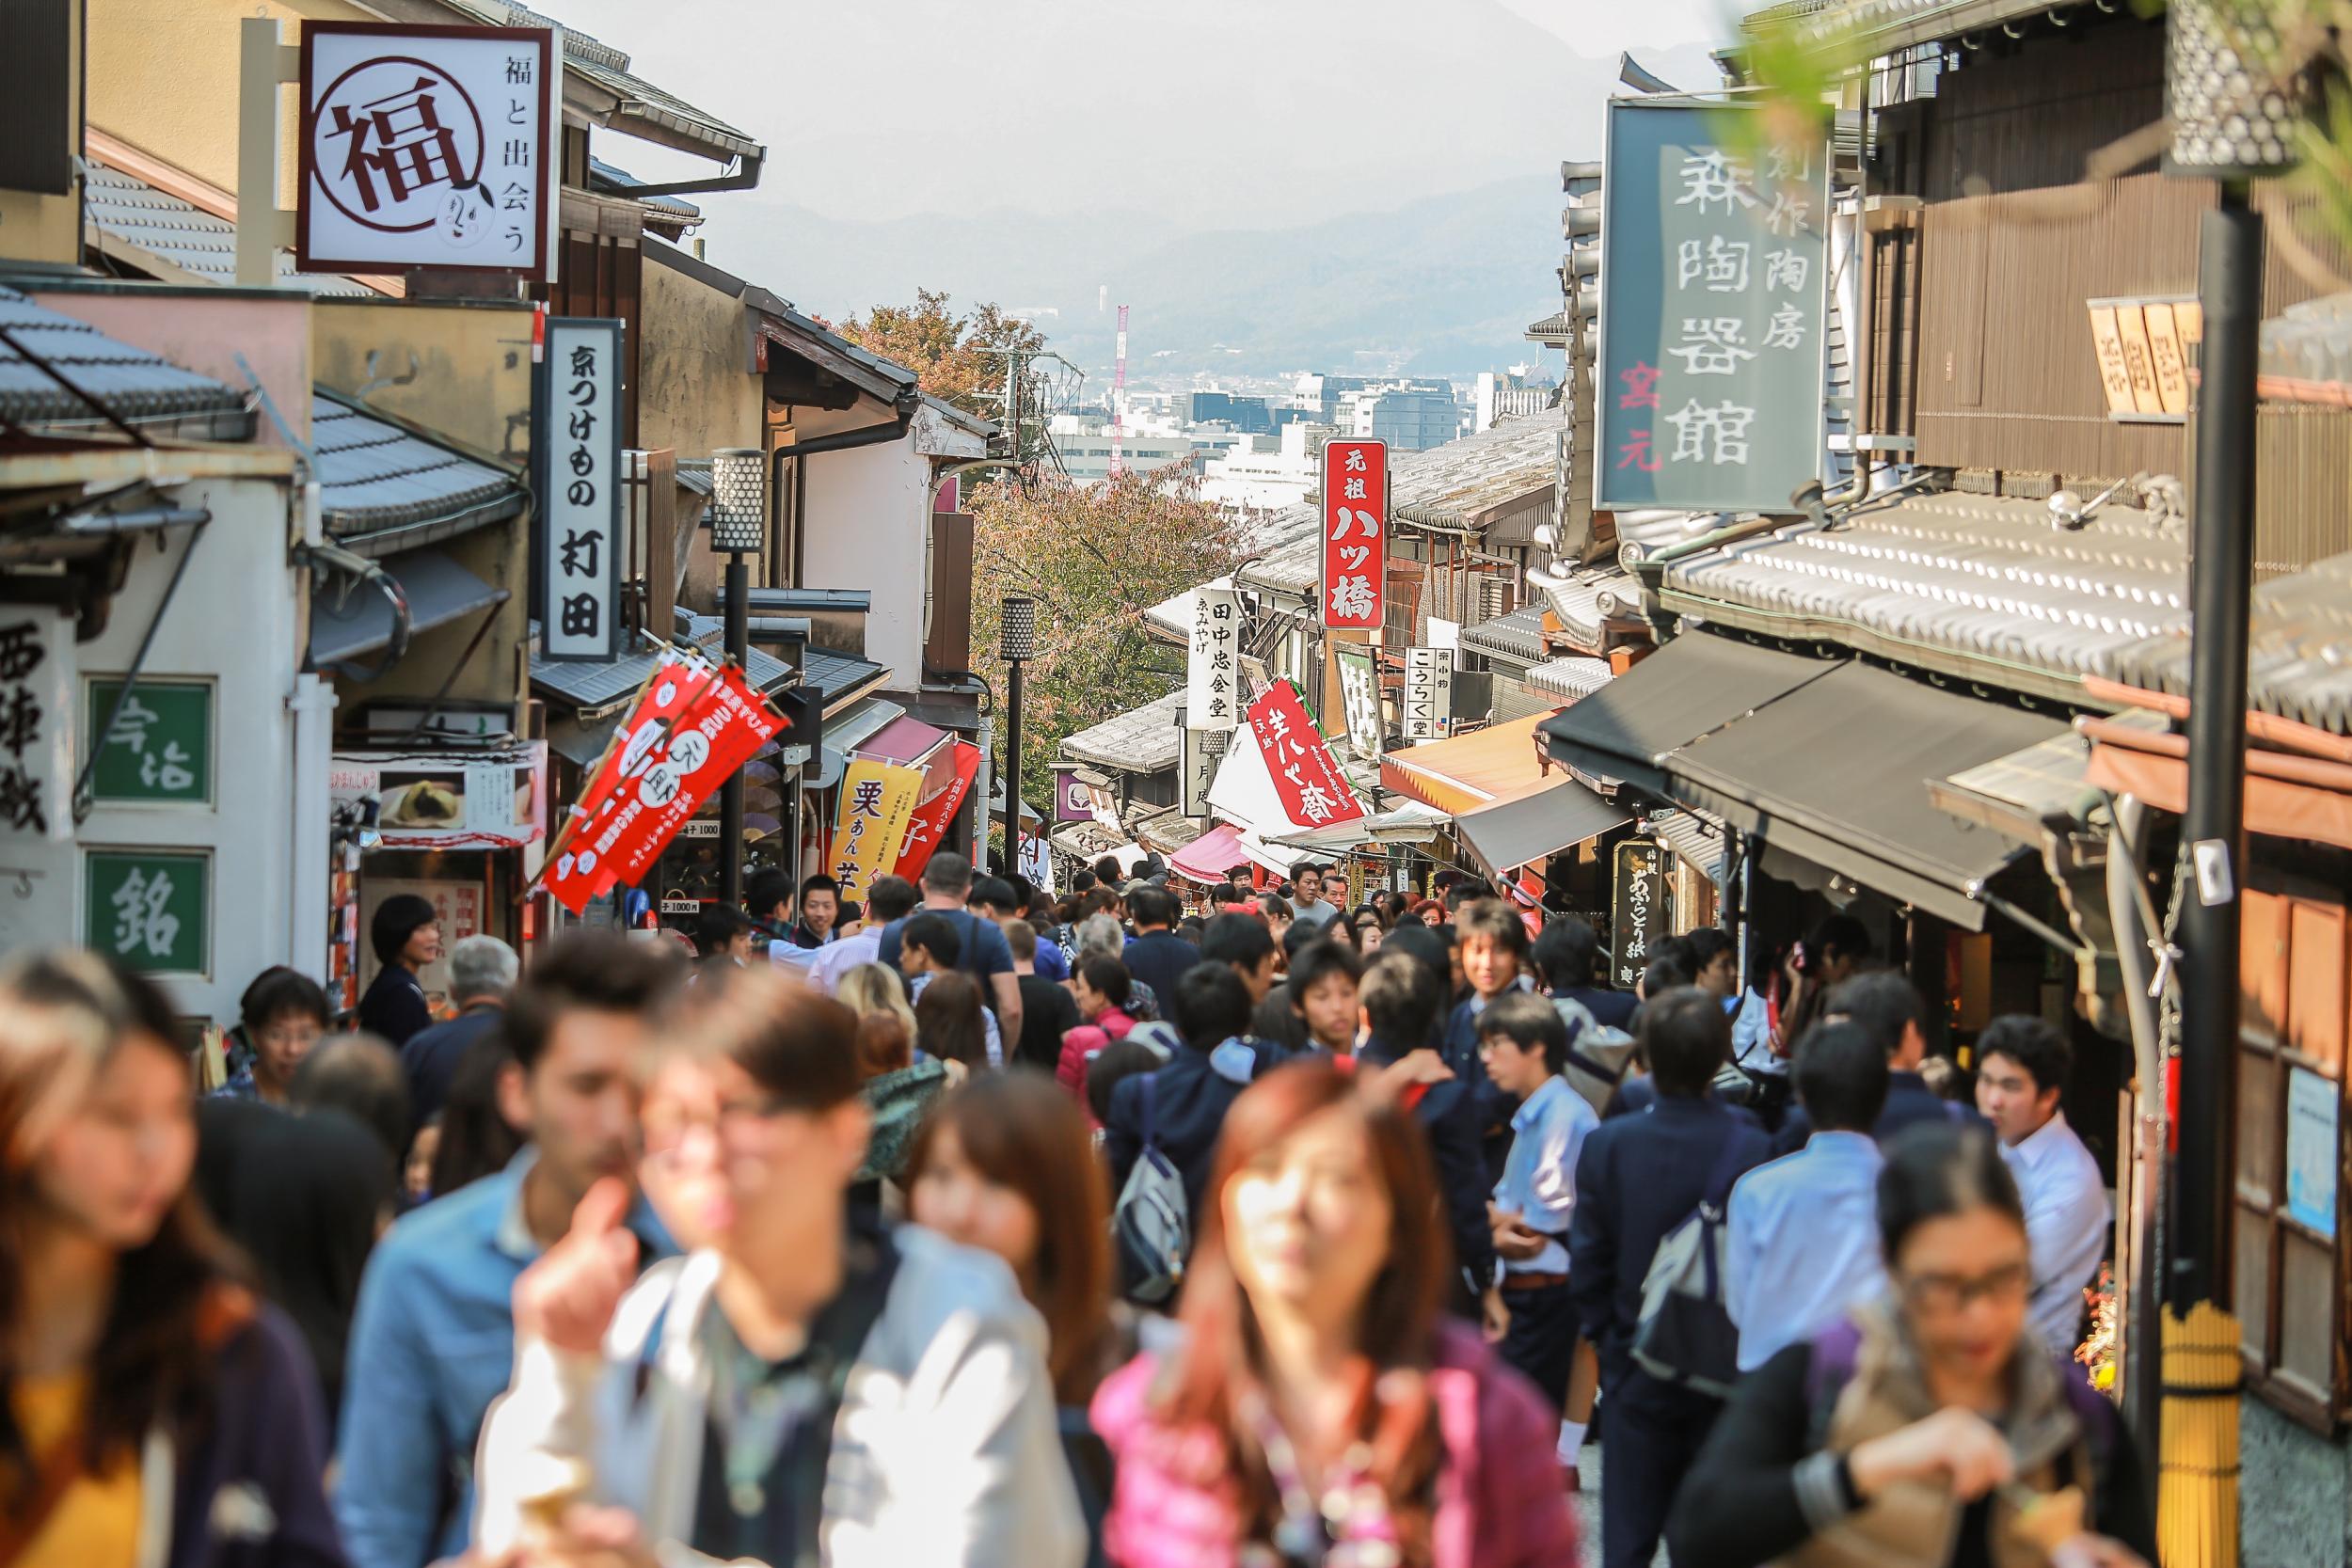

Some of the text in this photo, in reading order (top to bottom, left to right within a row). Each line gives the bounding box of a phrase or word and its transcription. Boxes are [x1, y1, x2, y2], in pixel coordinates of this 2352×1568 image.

[325, 76, 466, 213] 福
[502, 55, 532, 253] 福と出会う
[1663, 150, 1758, 466] 森陶器館
[1616, 360, 1664, 471] 窯元
[1195, 597, 1210, 656] 京みやげ
[1208, 602, 1232, 719] 田中忠金堂
[1438, 651, 1449, 689] 京小物
[1414, 652, 1429, 736] こうらく堂
[699, 824, 718, 835] 1000
[111, 866, 181, 957] 銘
[1625, 868, 1651, 958] あぶらとり紙
